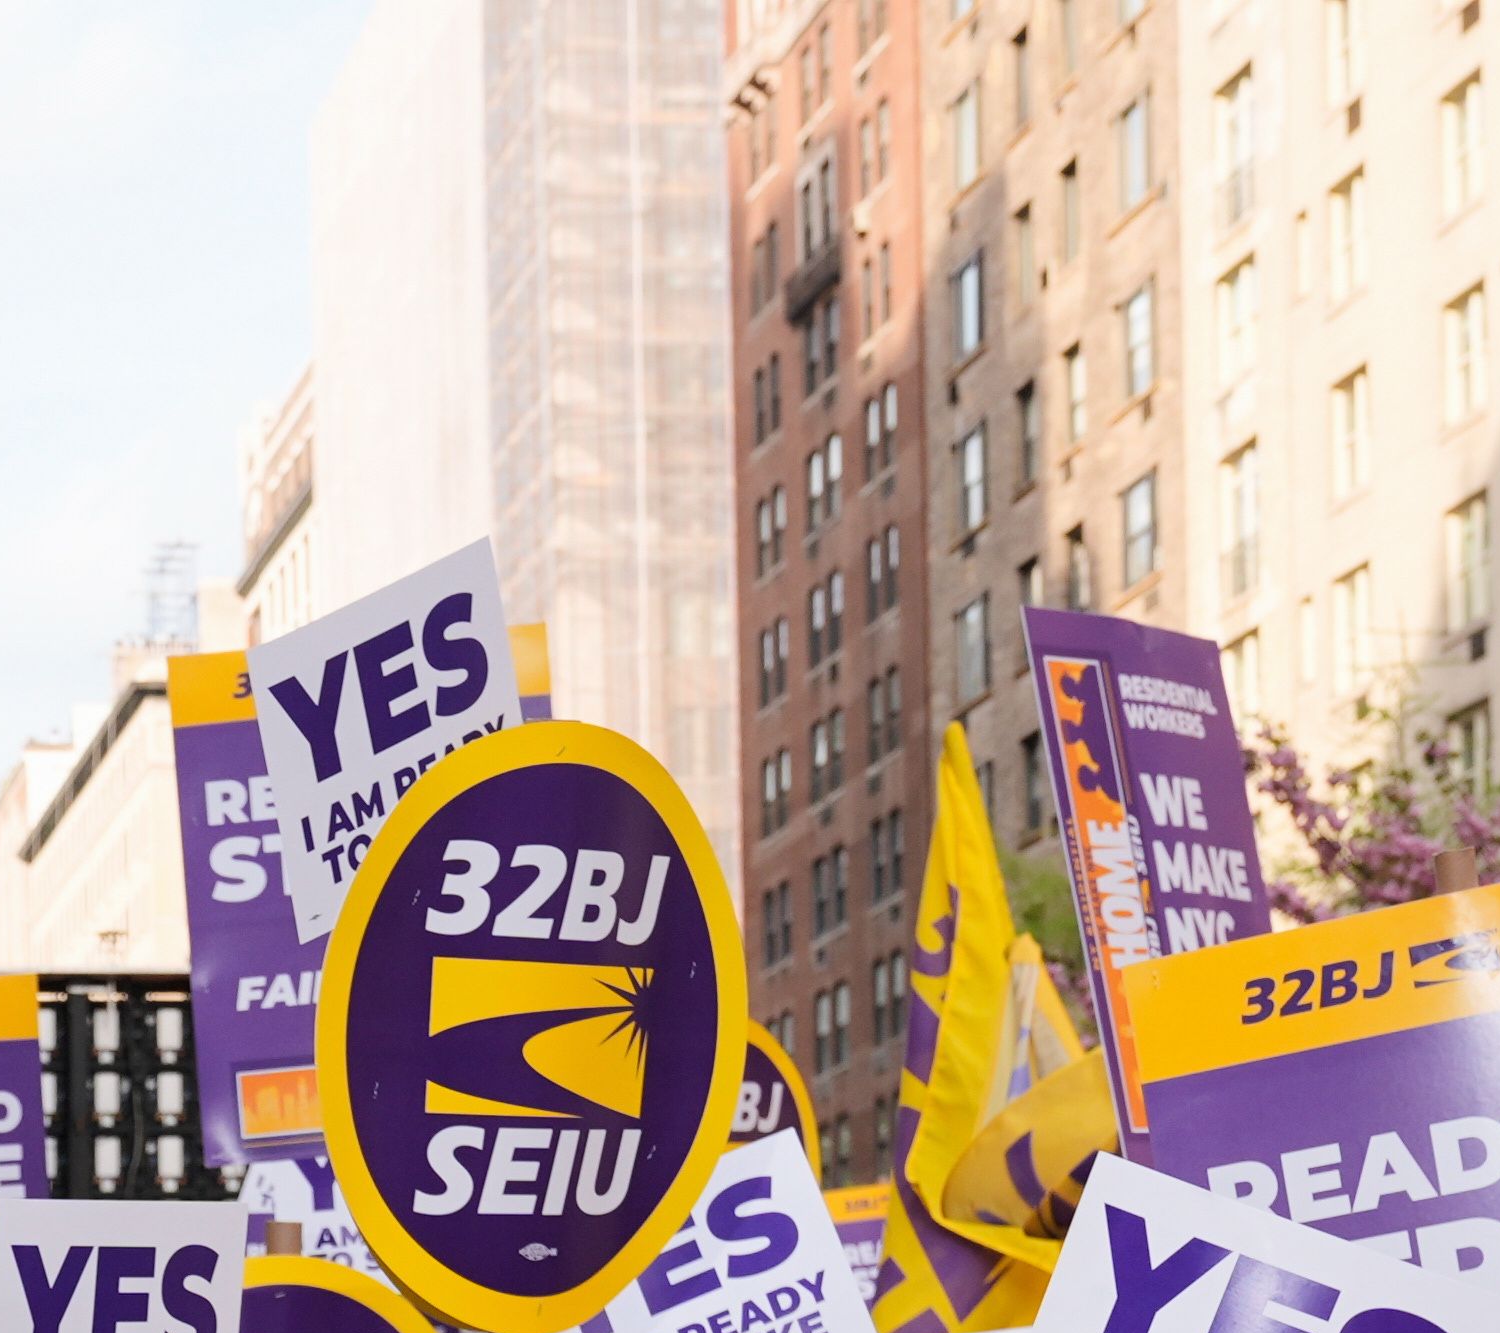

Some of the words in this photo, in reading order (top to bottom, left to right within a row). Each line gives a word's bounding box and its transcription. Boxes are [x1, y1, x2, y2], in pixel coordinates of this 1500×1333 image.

[268, 592, 490, 784] YES
[1117, 674, 1217, 716] RESIDENTIAL
[1124, 703, 1206, 739] WORKERS
[301, 815, 318, 852] I
[327, 780, 387, 843] AM
[1139, 773, 1208, 830] WE
[425, 839, 670, 946] 32BJ
[1152, 840, 1251, 902] MAKE
[1240, 950, 1395, 1026] 32BJ
[412, 1125, 641, 1217] SEIU
